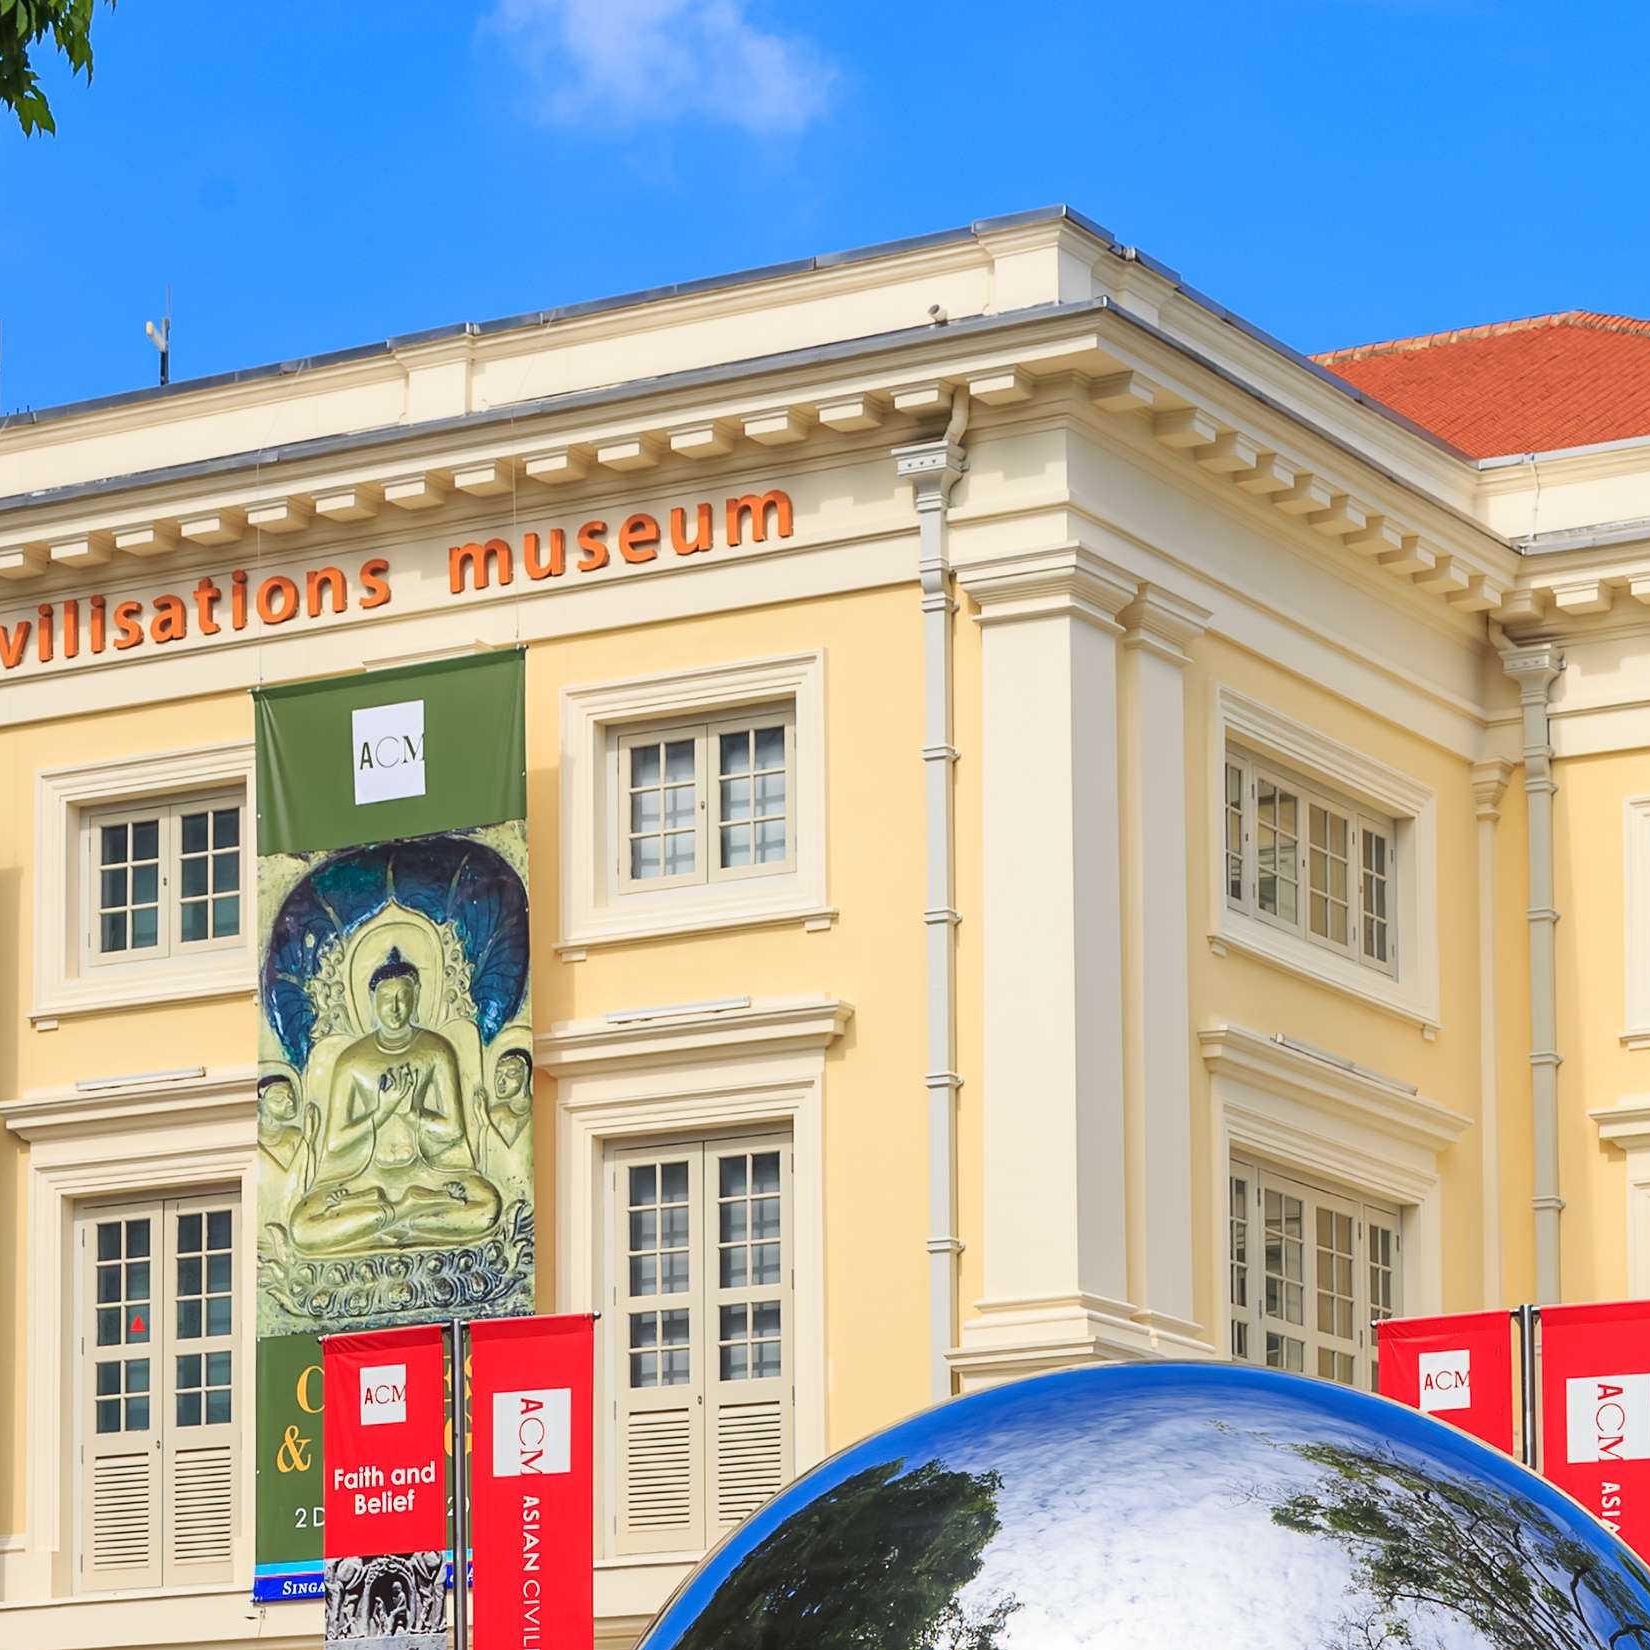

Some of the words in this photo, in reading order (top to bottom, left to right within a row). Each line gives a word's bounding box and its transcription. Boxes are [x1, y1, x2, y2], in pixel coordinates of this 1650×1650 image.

[448, 488, 794, 595] museum
[359, 730, 426, 771] ACM
[364, 1384, 407, 1406] ACM
[1423, 1369, 1471, 1392] ACM
[518, 1397, 544, 1475] ACM
[1595, 1382, 1626, 1462] ACM
[333, 1465, 385, 1491] Faith
[390, 1460, 436, 1485] and
[294, 1507, 307, 1529] 2
[354, 1488, 415, 1516] Belief
[521, 1494, 541, 1572] ASIAN
